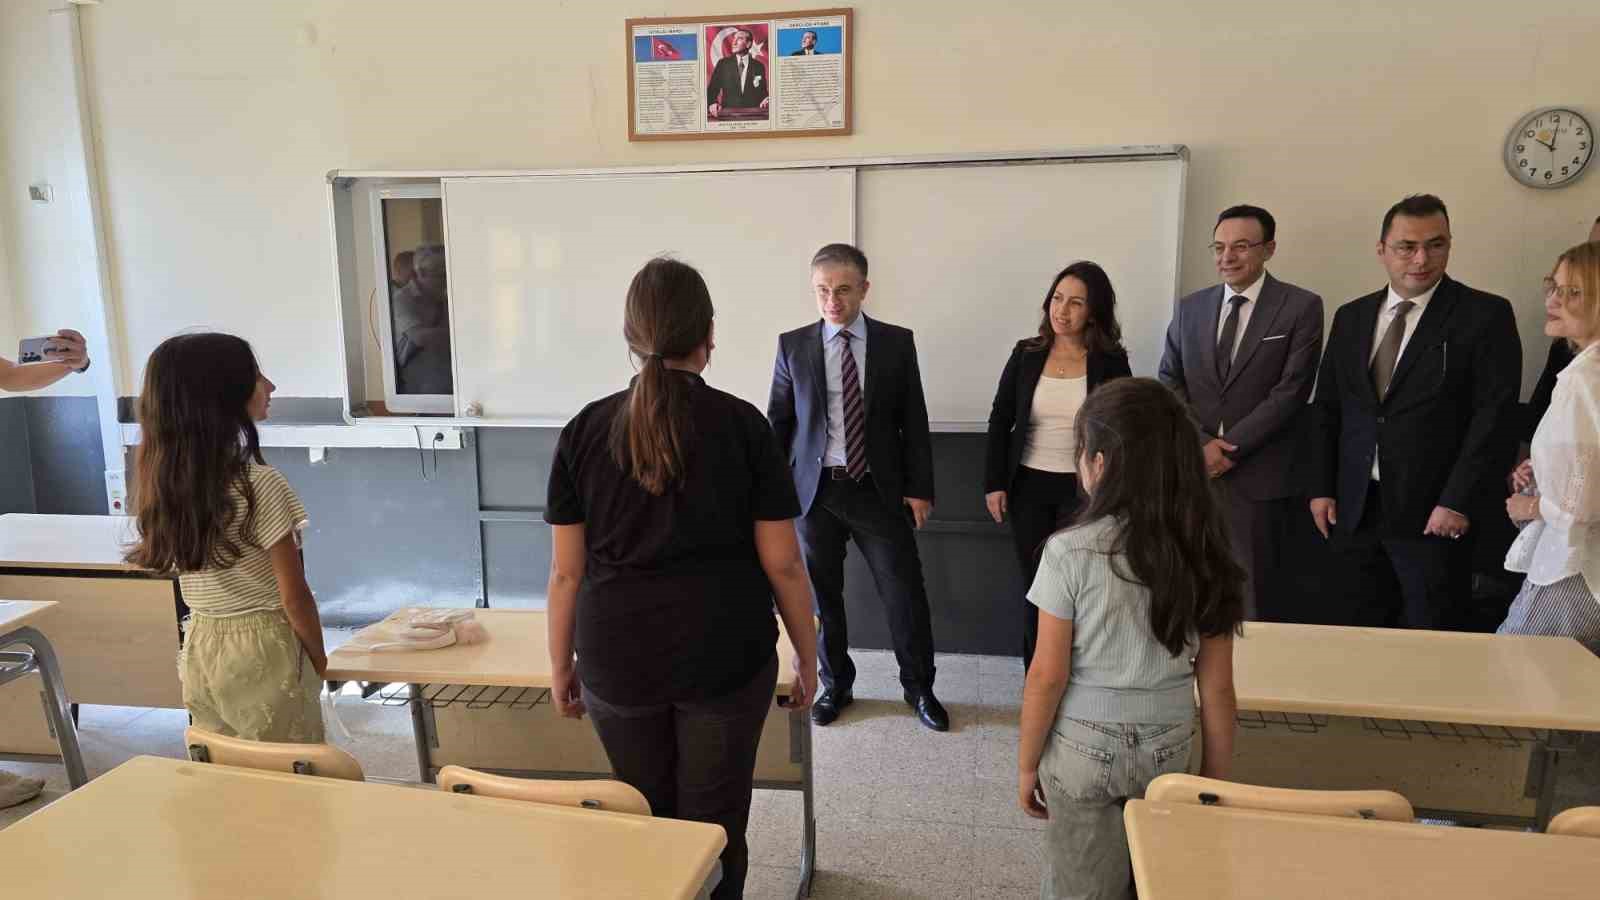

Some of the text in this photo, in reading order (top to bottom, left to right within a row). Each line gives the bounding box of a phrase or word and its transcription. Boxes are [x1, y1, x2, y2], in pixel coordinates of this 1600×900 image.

[1516, 144, 1525, 153] 9
[1529, 168, 1537, 176] 7
[1544, 170, 1553, 180] 6
[1561, 166, 1569, 176] 5
